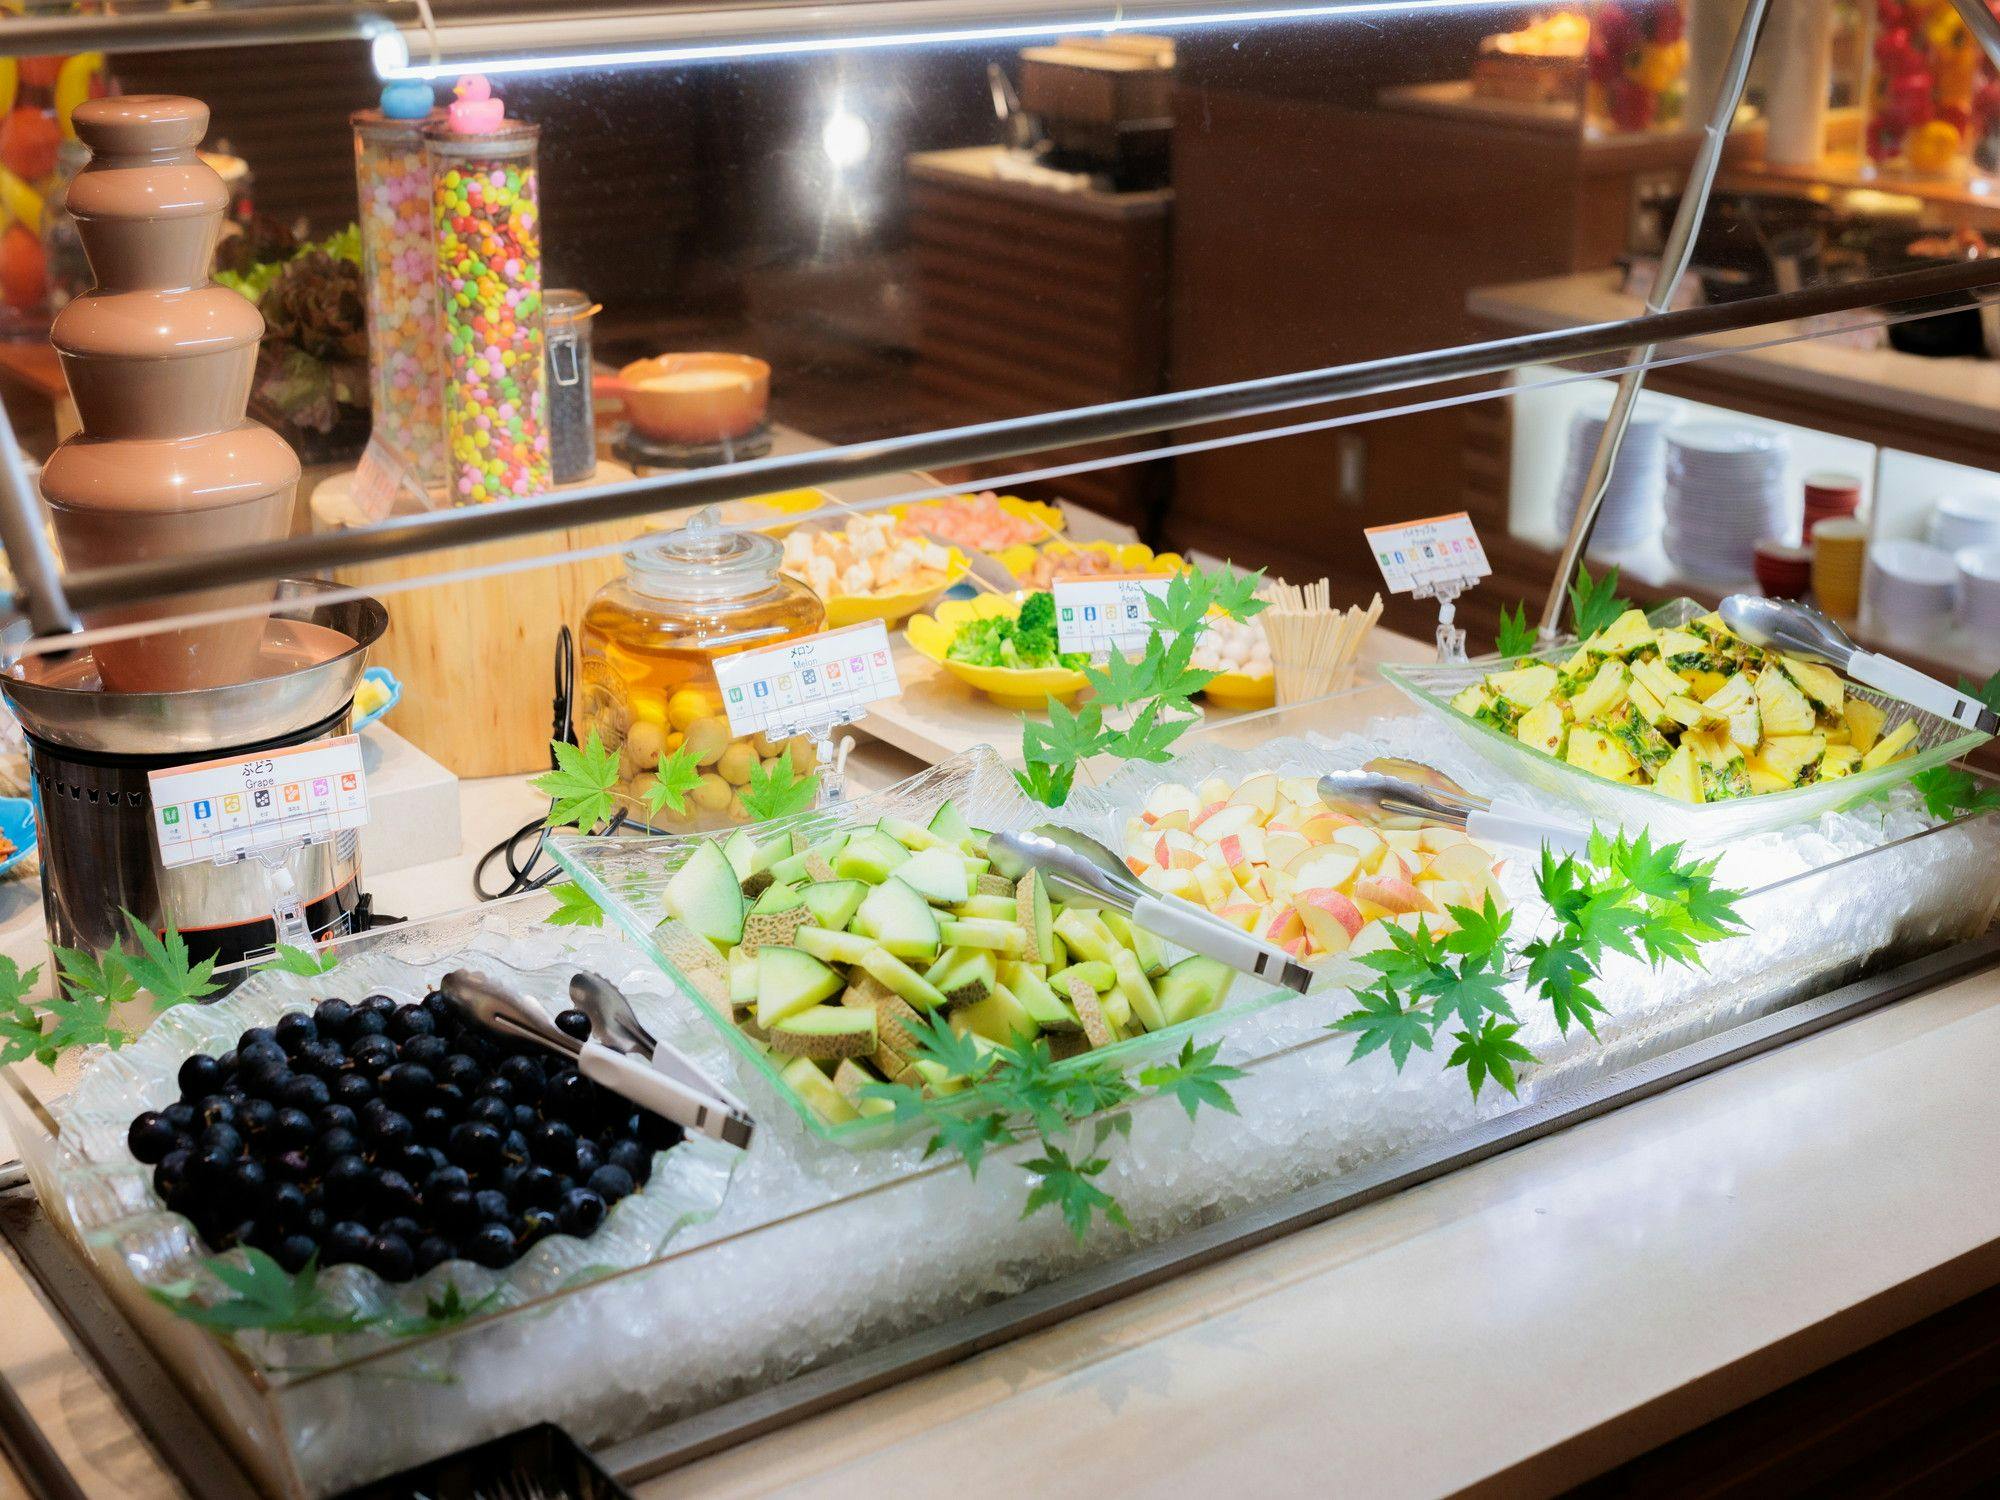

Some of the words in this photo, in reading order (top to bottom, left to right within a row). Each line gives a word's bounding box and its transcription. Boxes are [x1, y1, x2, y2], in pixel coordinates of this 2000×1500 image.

[1119, 580, 1141, 592] りんご
[790, 645, 815, 658] メロン
[793, 658, 818, 669] Melon
[242, 759, 274, 777] ぶどう
[245, 778, 274, 790] Grape
